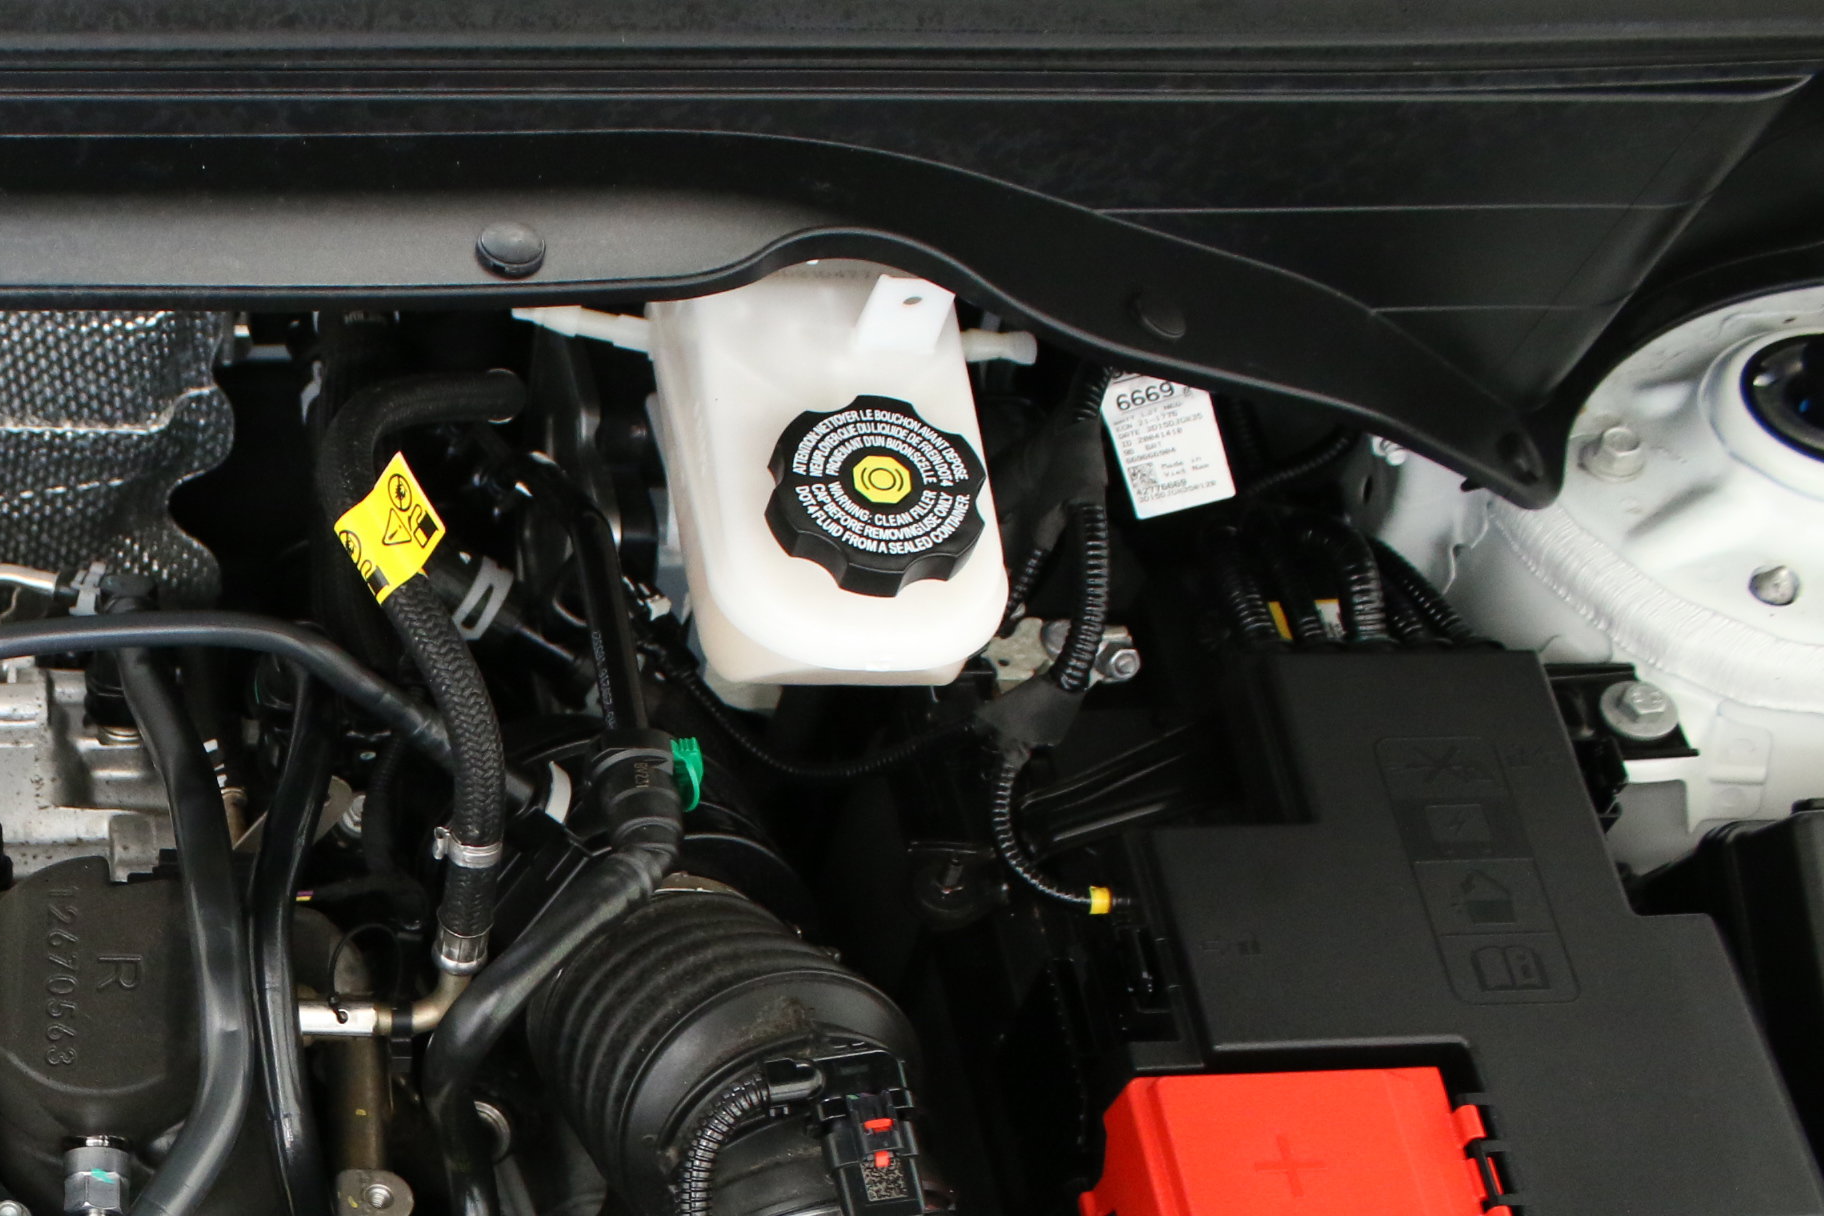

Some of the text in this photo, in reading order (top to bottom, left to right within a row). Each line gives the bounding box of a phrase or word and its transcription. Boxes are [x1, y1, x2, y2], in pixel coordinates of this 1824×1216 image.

[1116, 380, 1175, 411] 6669
[813, 410, 860, 436] NETTOYER
[860, 409, 873, 421] LE
[874, 409, 921, 432] BOUCHON
[918, 425, 950, 450] AVANT
[837, 425, 859, 441] QUE
[857, 422, 872, 434] DU
[871, 422, 909, 442] LIQUIDE
[906, 433, 922, 447] DE
[917, 441, 942, 465] FREIN
[825, 435, 938, 485] PROVENANT D'UN BIDON SCELLE
[795, 485, 816, 506] DOT
[807, 505, 820, 514] 4
[811, 483, 832, 504] CAP
[823, 501, 866, 533] BEFORE
[934, 491, 954, 517] ONLY
[828, 481, 937, 527] WARNING: CLEAN FILLER
[811, 510, 844, 537] FLUID
[842, 531, 878, 552] FROM
[878, 541, 888, 554] A
[888, 536, 933, 554] SEALED
[45, 886, 80, 1068] 12670563
[97, 953, 145, 993] R
